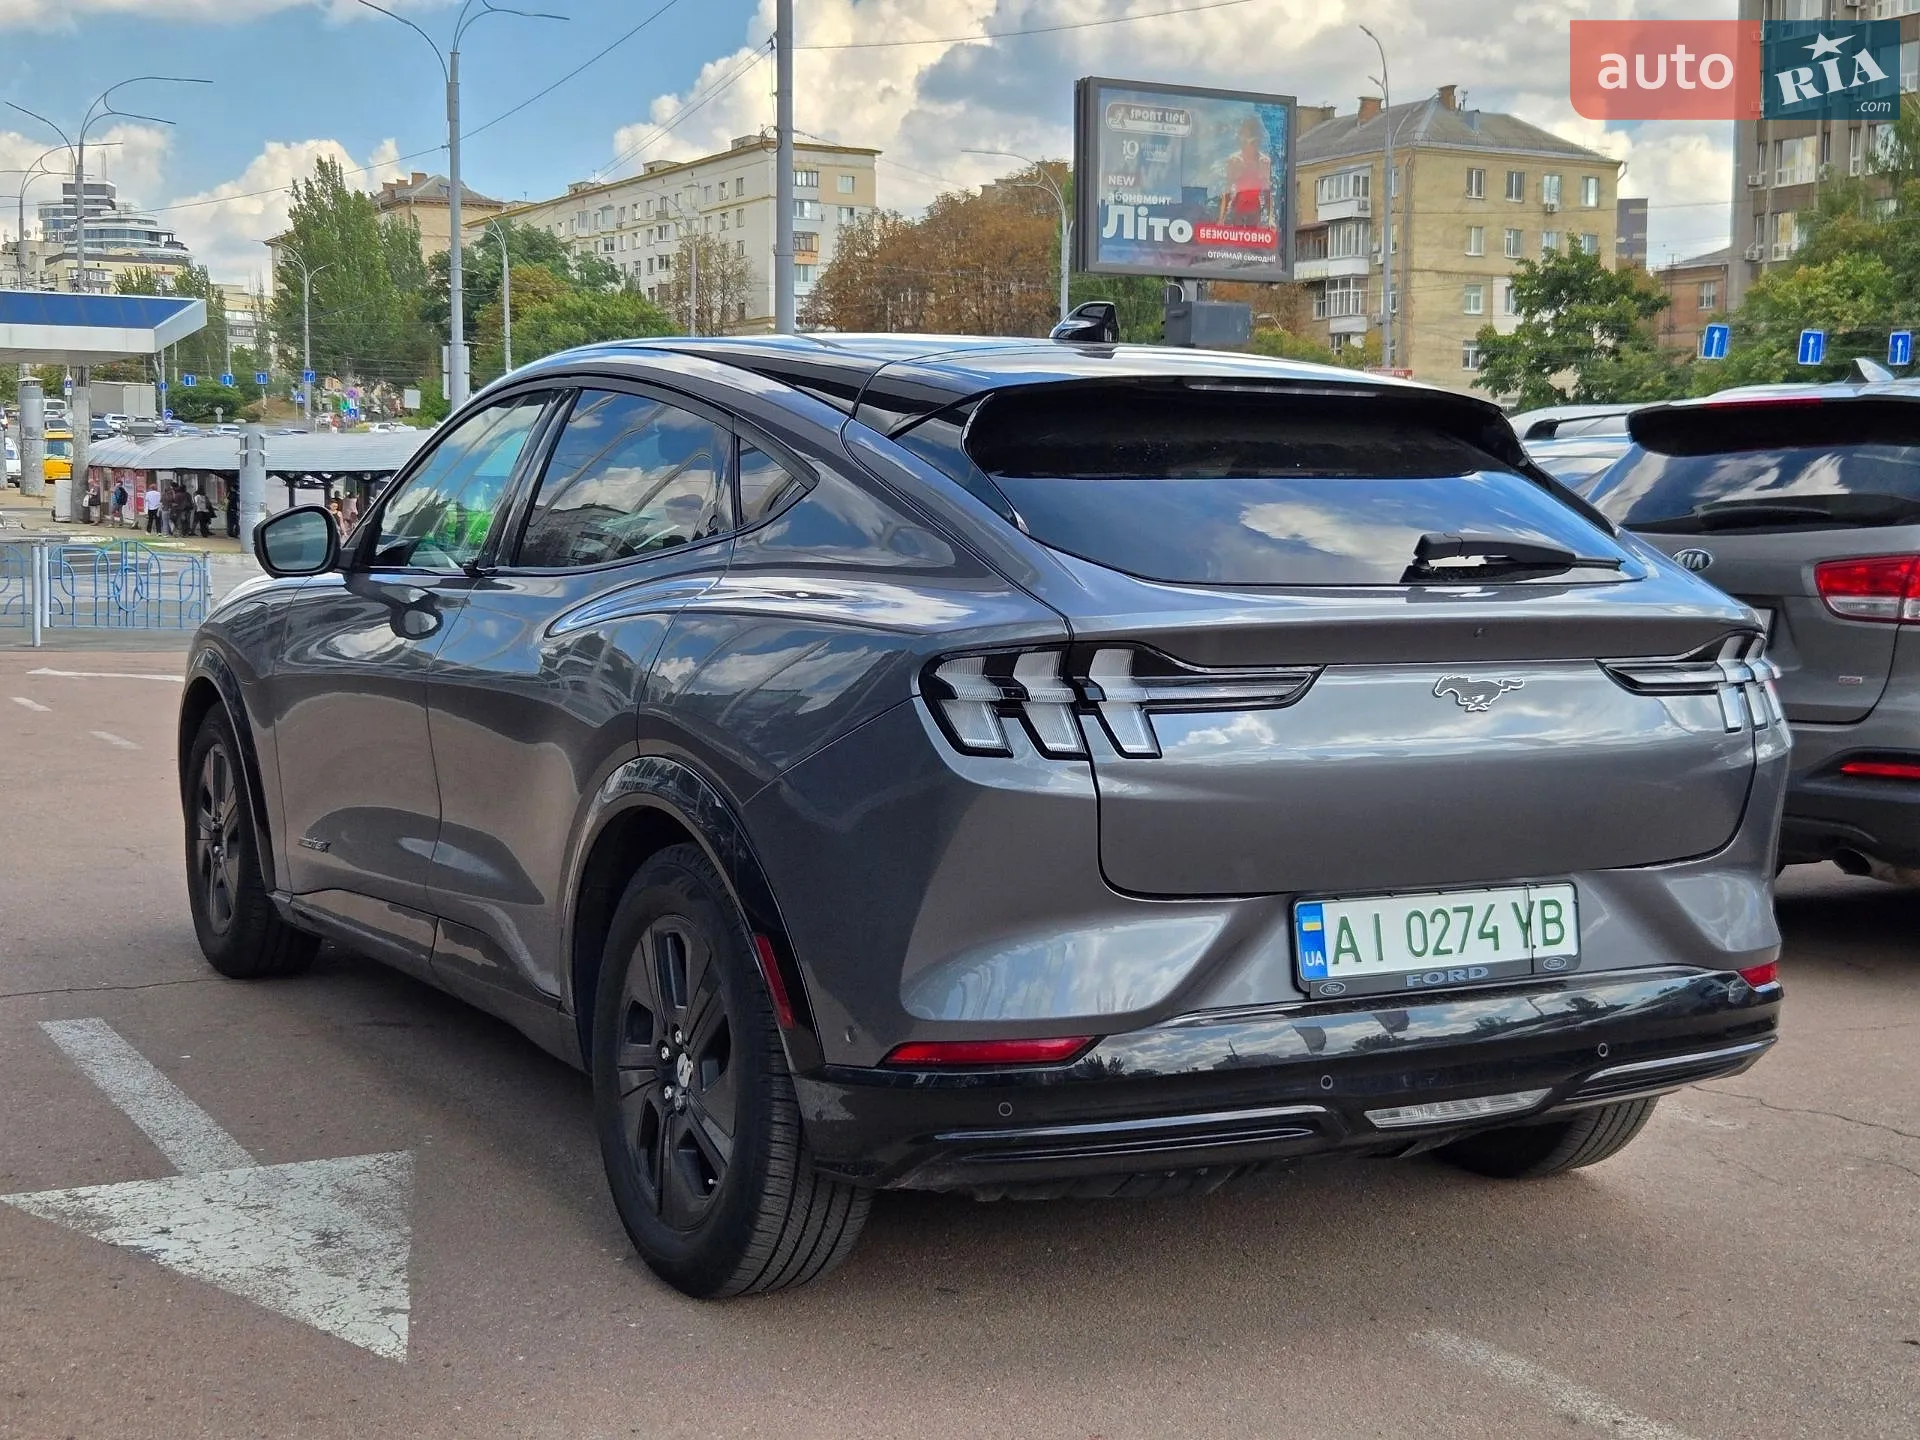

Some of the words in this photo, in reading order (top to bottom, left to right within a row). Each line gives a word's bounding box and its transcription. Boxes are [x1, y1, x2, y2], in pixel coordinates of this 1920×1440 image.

[1129, 107, 1163, 121] SPORT
[1108, 175, 1135, 187] NEW
[1102, 204, 1193, 244] Літо
[1199, 228, 1272, 244] БЕЗКОШТОВНО
[1332, 912, 1383, 966] AI
[1405, 902, 1500, 958] 0274
[1511, 898, 1565, 949] YB
[1305, 950, 1325, 967] UA
[1405, 966, 1489, 988] FORD
